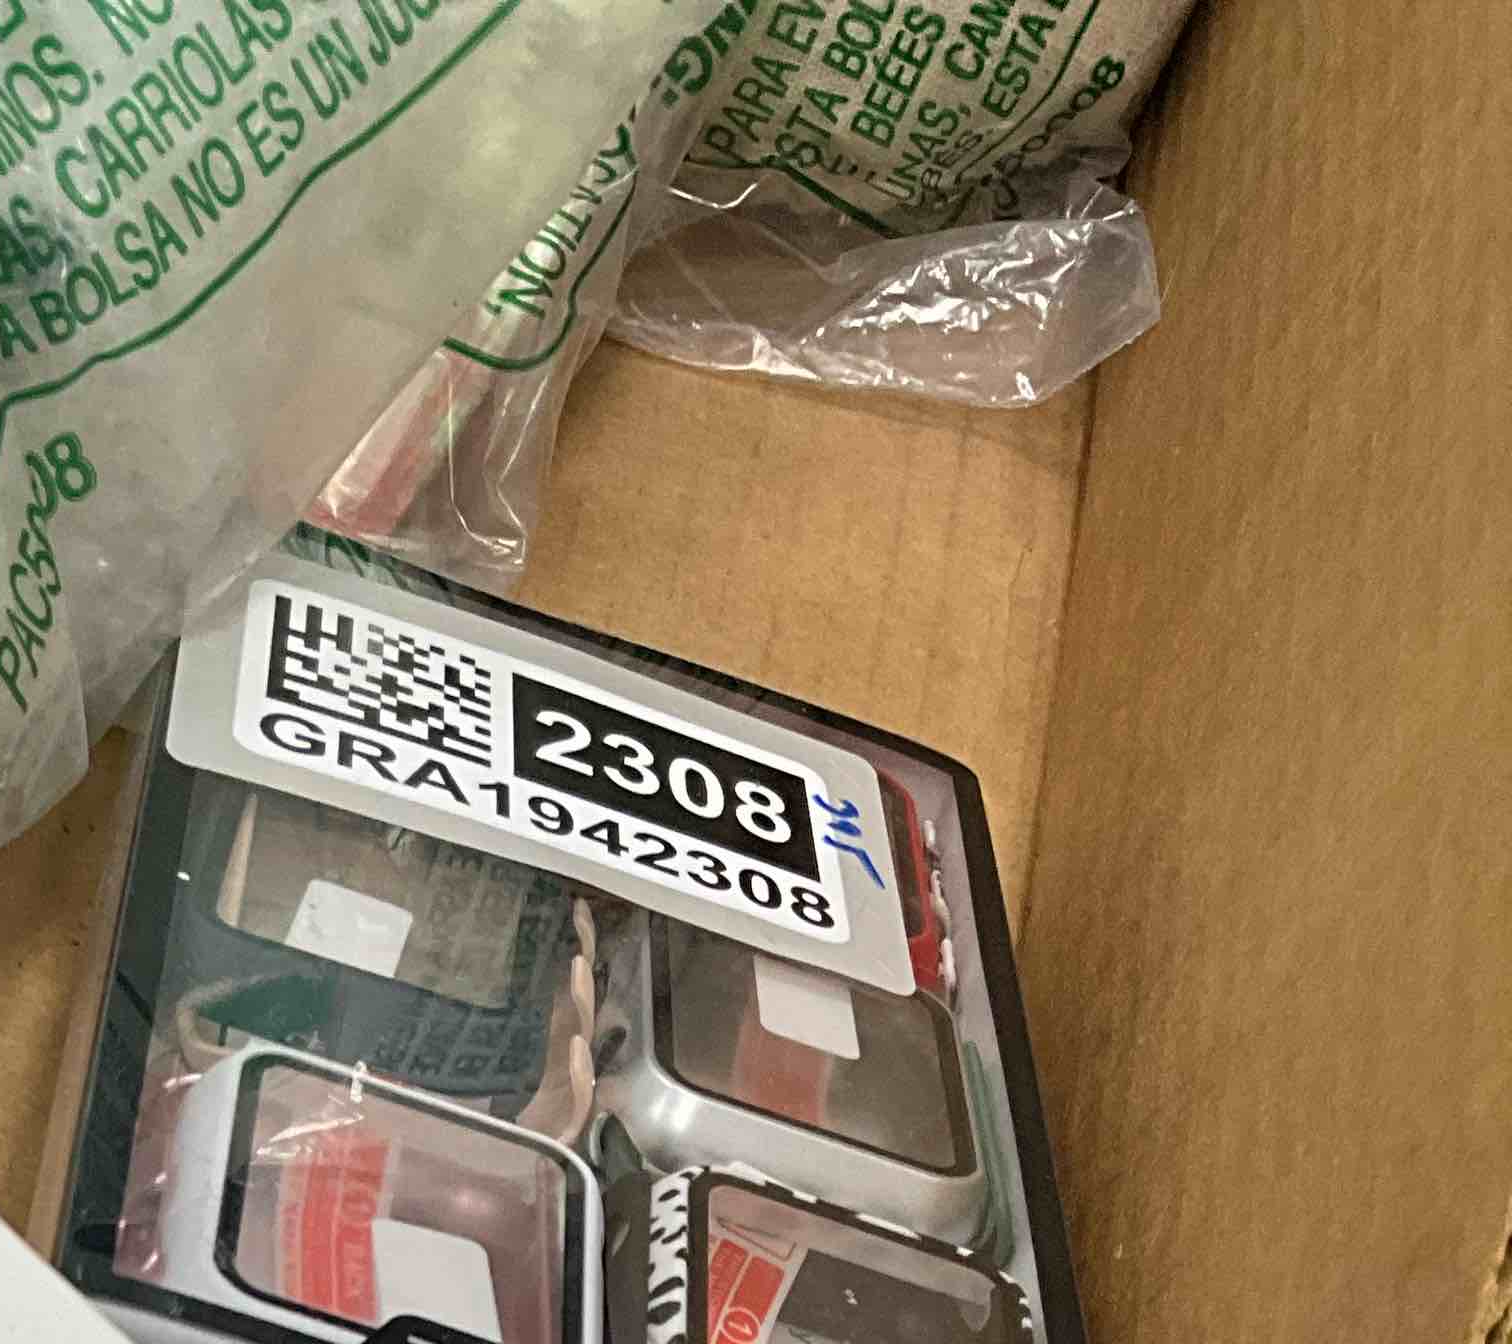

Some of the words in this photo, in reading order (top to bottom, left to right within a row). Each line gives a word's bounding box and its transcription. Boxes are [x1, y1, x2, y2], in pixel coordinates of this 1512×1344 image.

[28, 198, 188, 346] BOLSA
[170, 137, 246, 239] NO
[238, 82, 305, 177] ES
[291, 17, 370, 119] UN
[703, 55, 801, 159] PARA
[259, 711, 836, 931] GRA1942308
[534, 709, 794, 848] 2308
